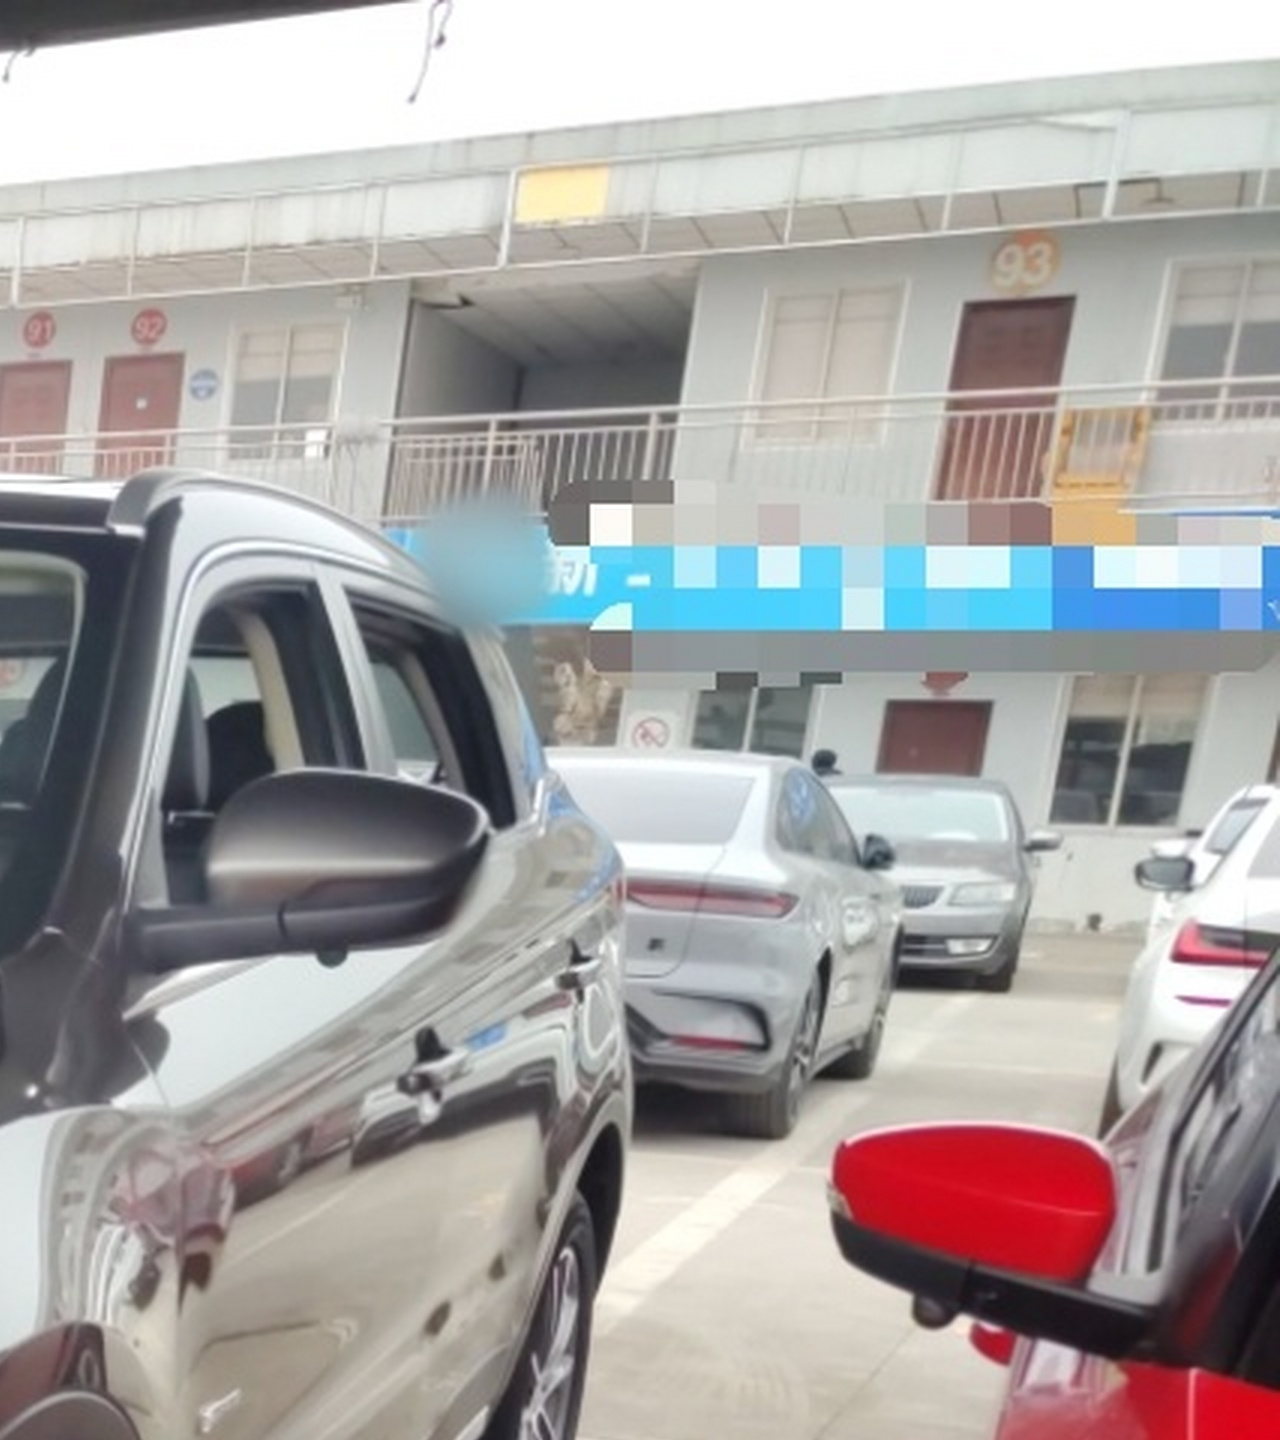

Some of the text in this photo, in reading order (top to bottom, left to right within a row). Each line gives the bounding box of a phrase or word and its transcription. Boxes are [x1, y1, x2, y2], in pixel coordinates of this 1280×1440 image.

[994, 242, 1052, 286] 93
[28, 319, 53, 343] 91
[136, 317, 163, 341] 92
